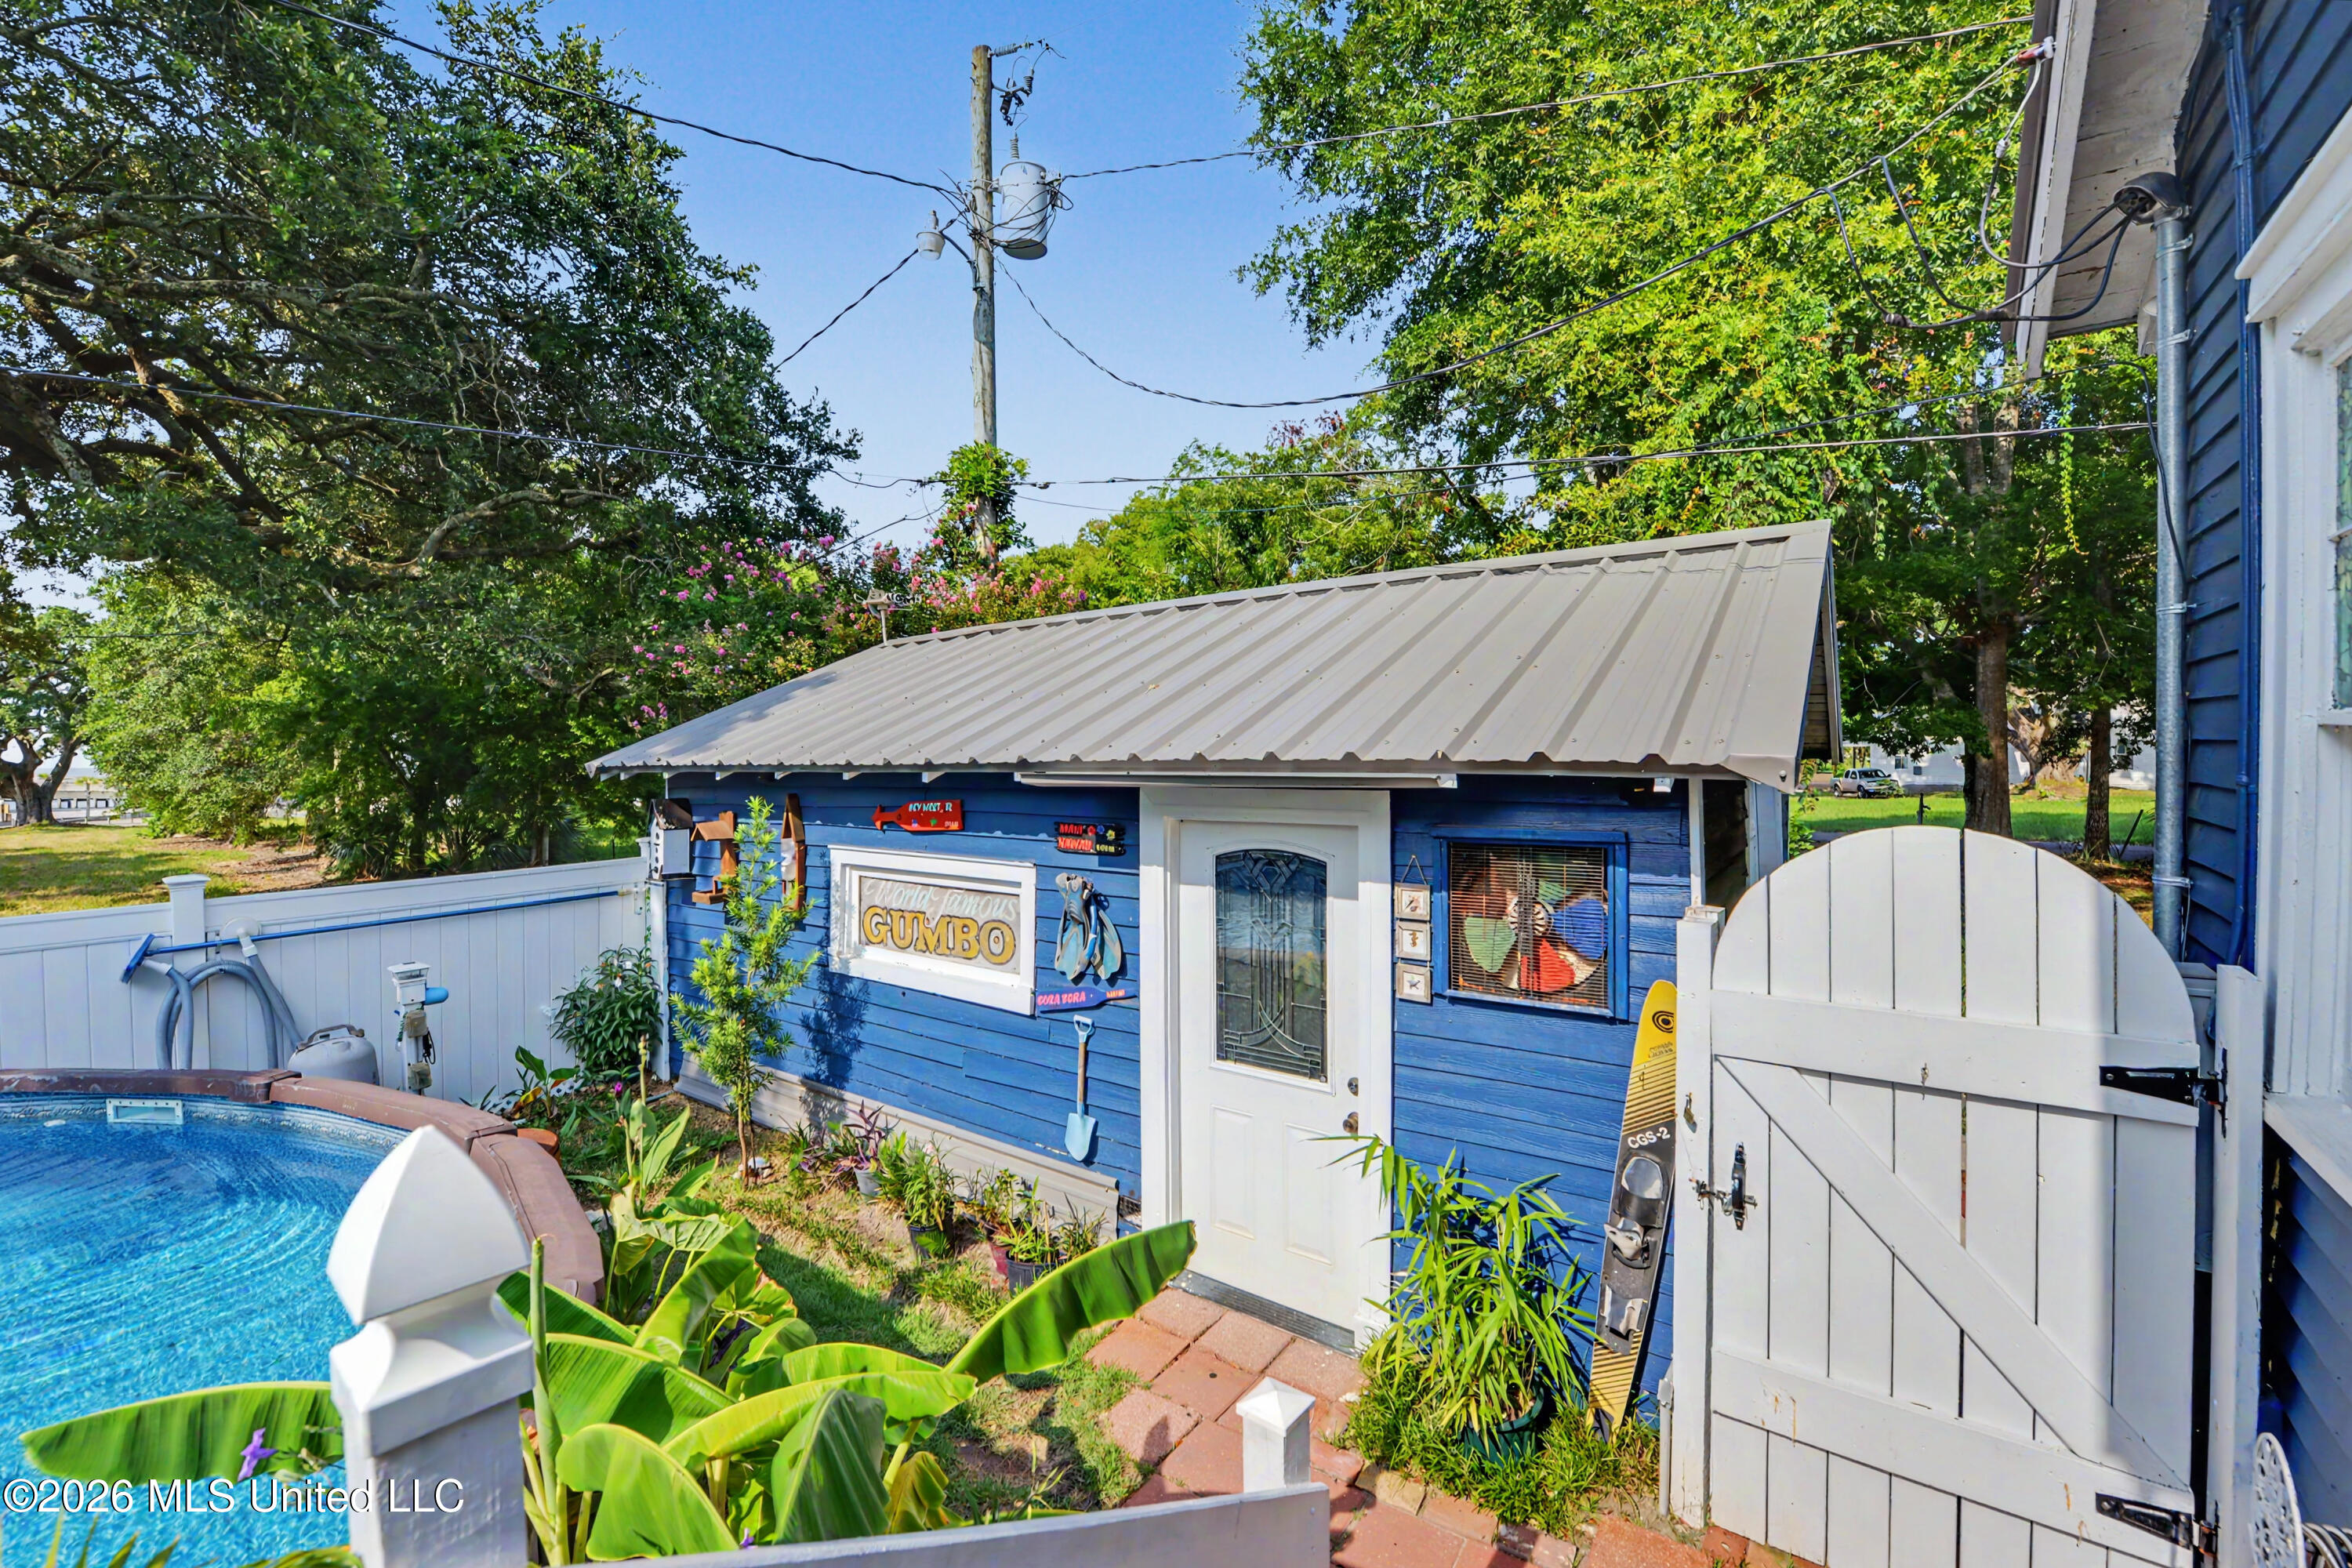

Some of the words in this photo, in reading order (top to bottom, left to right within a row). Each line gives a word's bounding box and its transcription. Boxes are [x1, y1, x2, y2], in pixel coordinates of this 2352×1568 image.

[864, 879, 935, 911] World
[862, 905, 1016, 964] GUMBO
[1628, 1127, 1671, 1149] CGS-2
